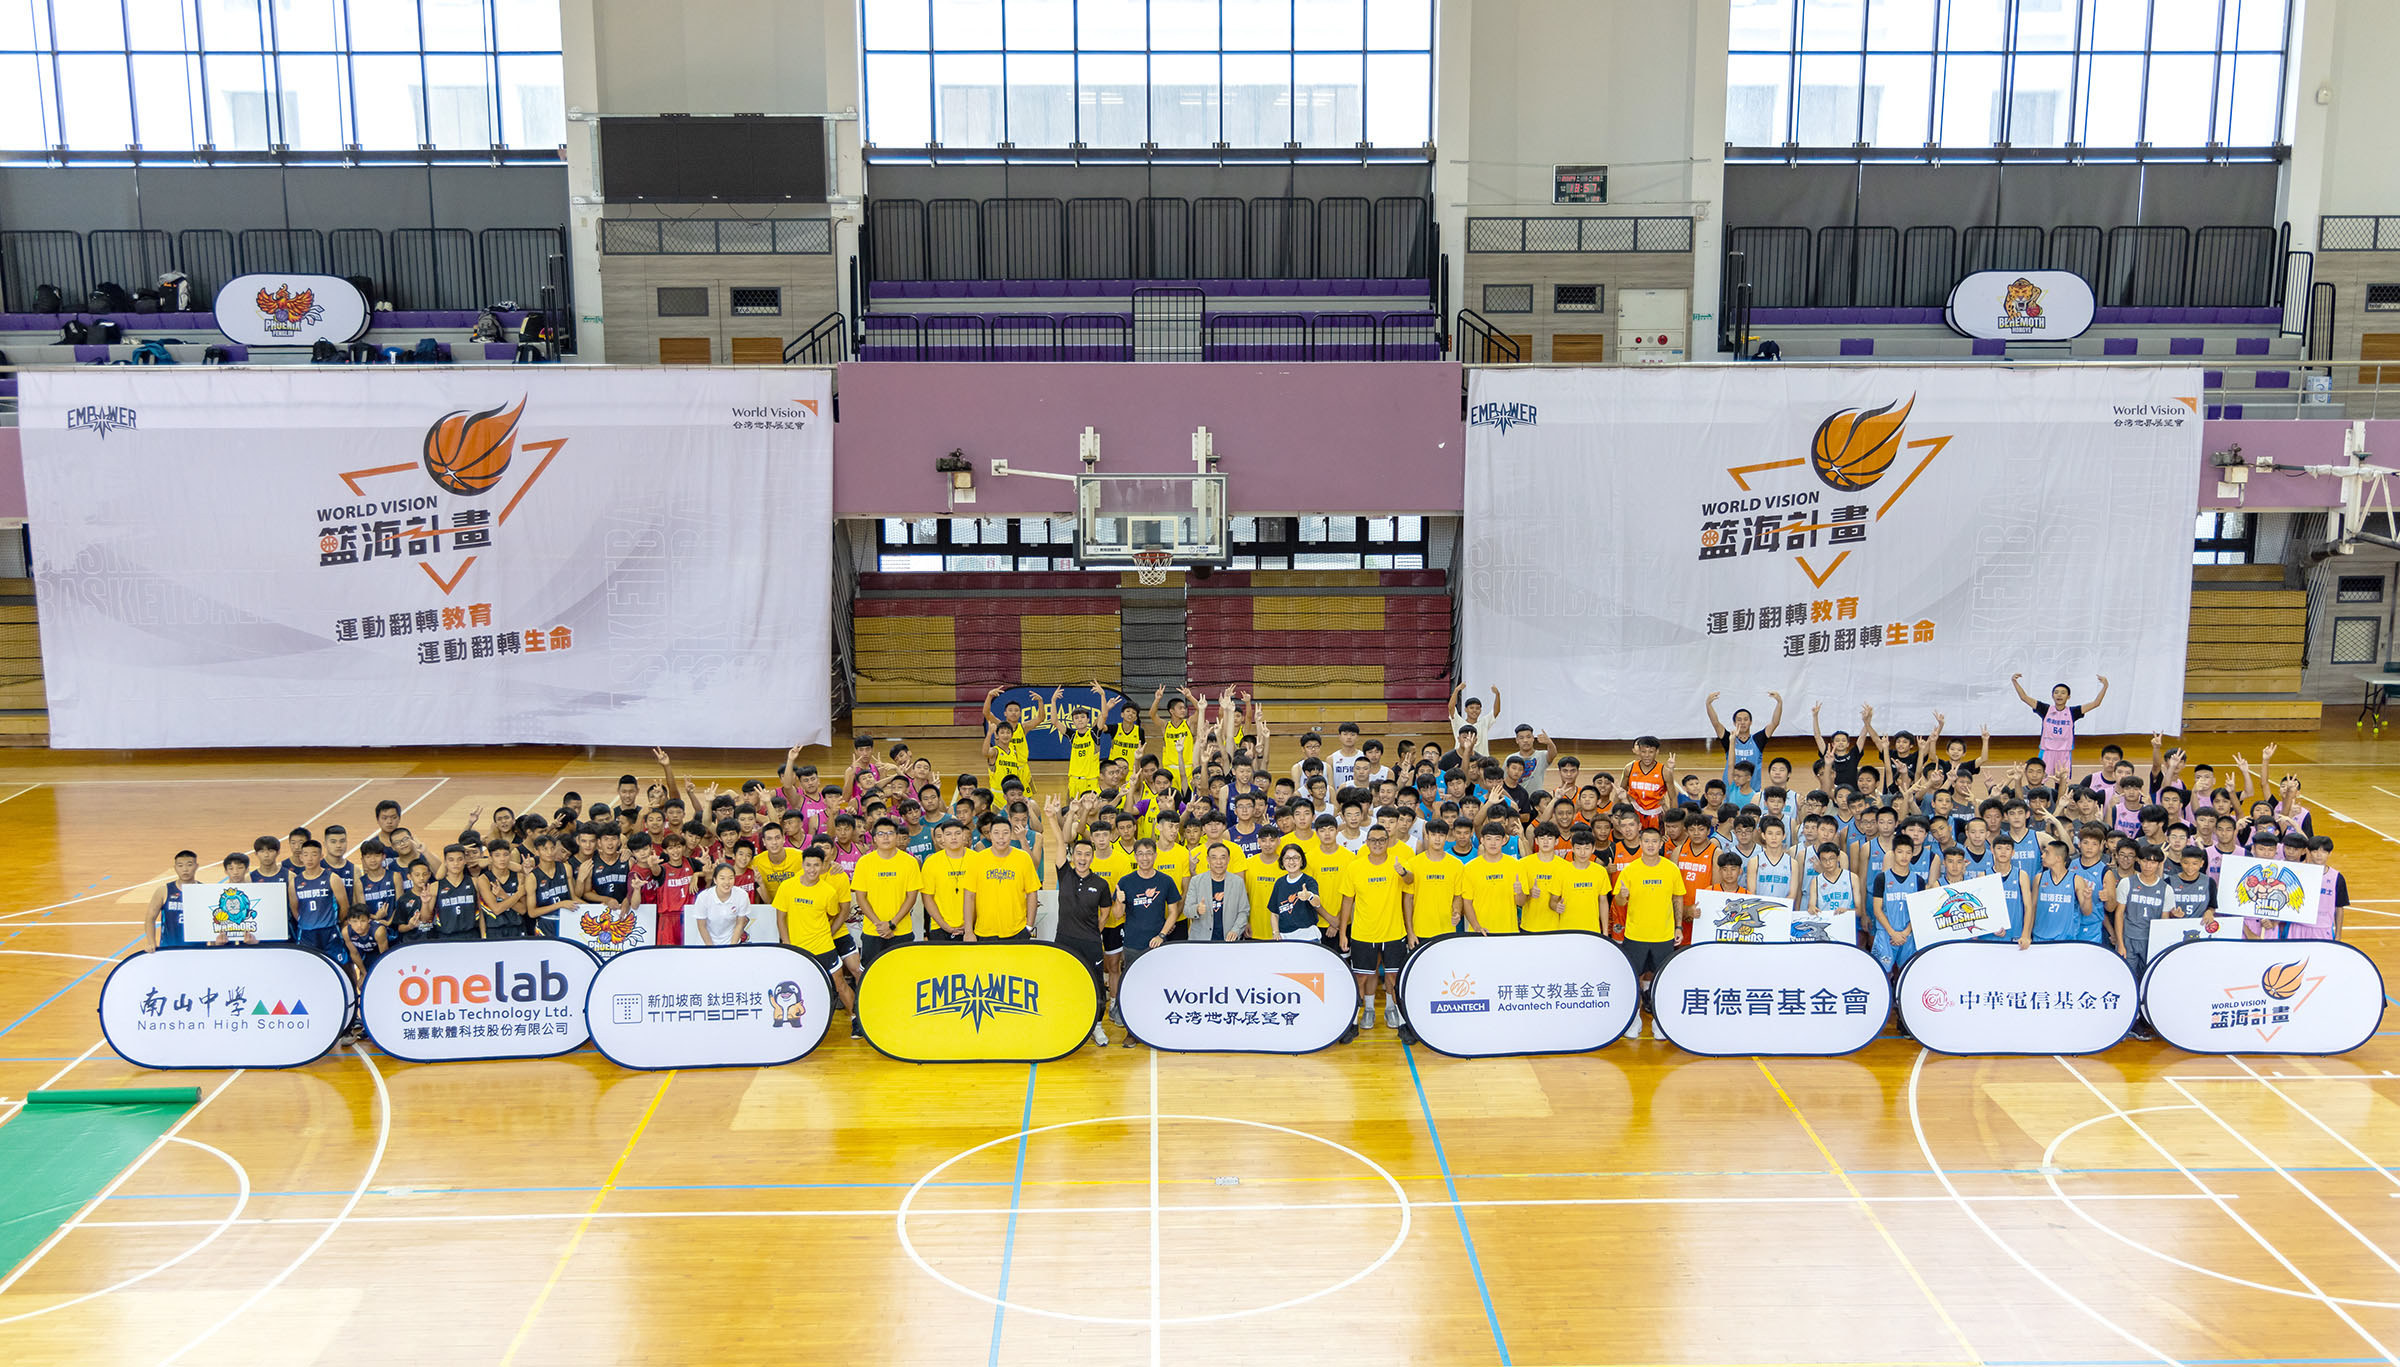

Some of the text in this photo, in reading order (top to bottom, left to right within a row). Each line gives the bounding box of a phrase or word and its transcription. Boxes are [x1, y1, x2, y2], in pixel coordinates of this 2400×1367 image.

[265, 319, 302, 331] PHOENIX
[1998, 316, 2045, 329] BEHEMOTH
[732, 407, 806, 418] World Vision
[2113, 405, 2185, 415] World Vision
[317, 496, 437, 522] WORLD VISION
[1702, 491, 1820, 516] WORLD VISION
[318, 509, 492, 567] 籃海計畫
[1698, 505, 1869, 560] 籃海計畫
[335, 603, 492, 642] 運動翻轉教育
[1707, 597, 1859, 635] 運動翻轉教育
[418, 625, 573, 664] 運動翻轉生命
[1784, 620, 1936, 658] 運動翻轉生命
[1686, 872, 1696, 881] 23
[609, 884, 614, 892] 2
[681, 888, 685, 897] 1
[456, 906, 461, 914] 6
[1899, 902, 1903, 911] 7
[2049, 903, 2060, 912] 27
[2143, 907, 2148, 917] 1
[2186, 905, 2193, 914] 5
[1935, 907, 1988, 930] WILDSHARK
[212, 921, 257, 933] WARRIORS
[1716, 929, 1764, 942] LEOPARDS
[588, 941, 623, 951] PHOENIX
[399, 960, 569, 1006] onelab
[1163, 986, 1301, 1004] World Vision
[1498, 981, 1611, 1000] 研華文教基金會
[139, 986, 247, 1017] 南山中學
[648, 991, 762, 1008] 新加坡商 鈦坦科技
[1498, 1000, 1610, 1012] Advantech Foundation
[1681, 987, 1871, 1016] 唐德晉基金會
[1960, 991, 2121, 1010] 中華電信基金會
[2211, 999, 2267, 1010] WORLD VISION
[401, 1006, 573, 1022] ONElab Technology Ltd.
[1436, 1002, 1485, 1013] ADVANTECH
[648, 1009, 763, 1022] TITANSOFT
[2210, 1005, 2290, 1029] 籃海計畫
[138, 1018, 310, 1032] Nanshan High School
[403, 1022, 568, 1040] 瑞嘉軟體科技股份有限公司
